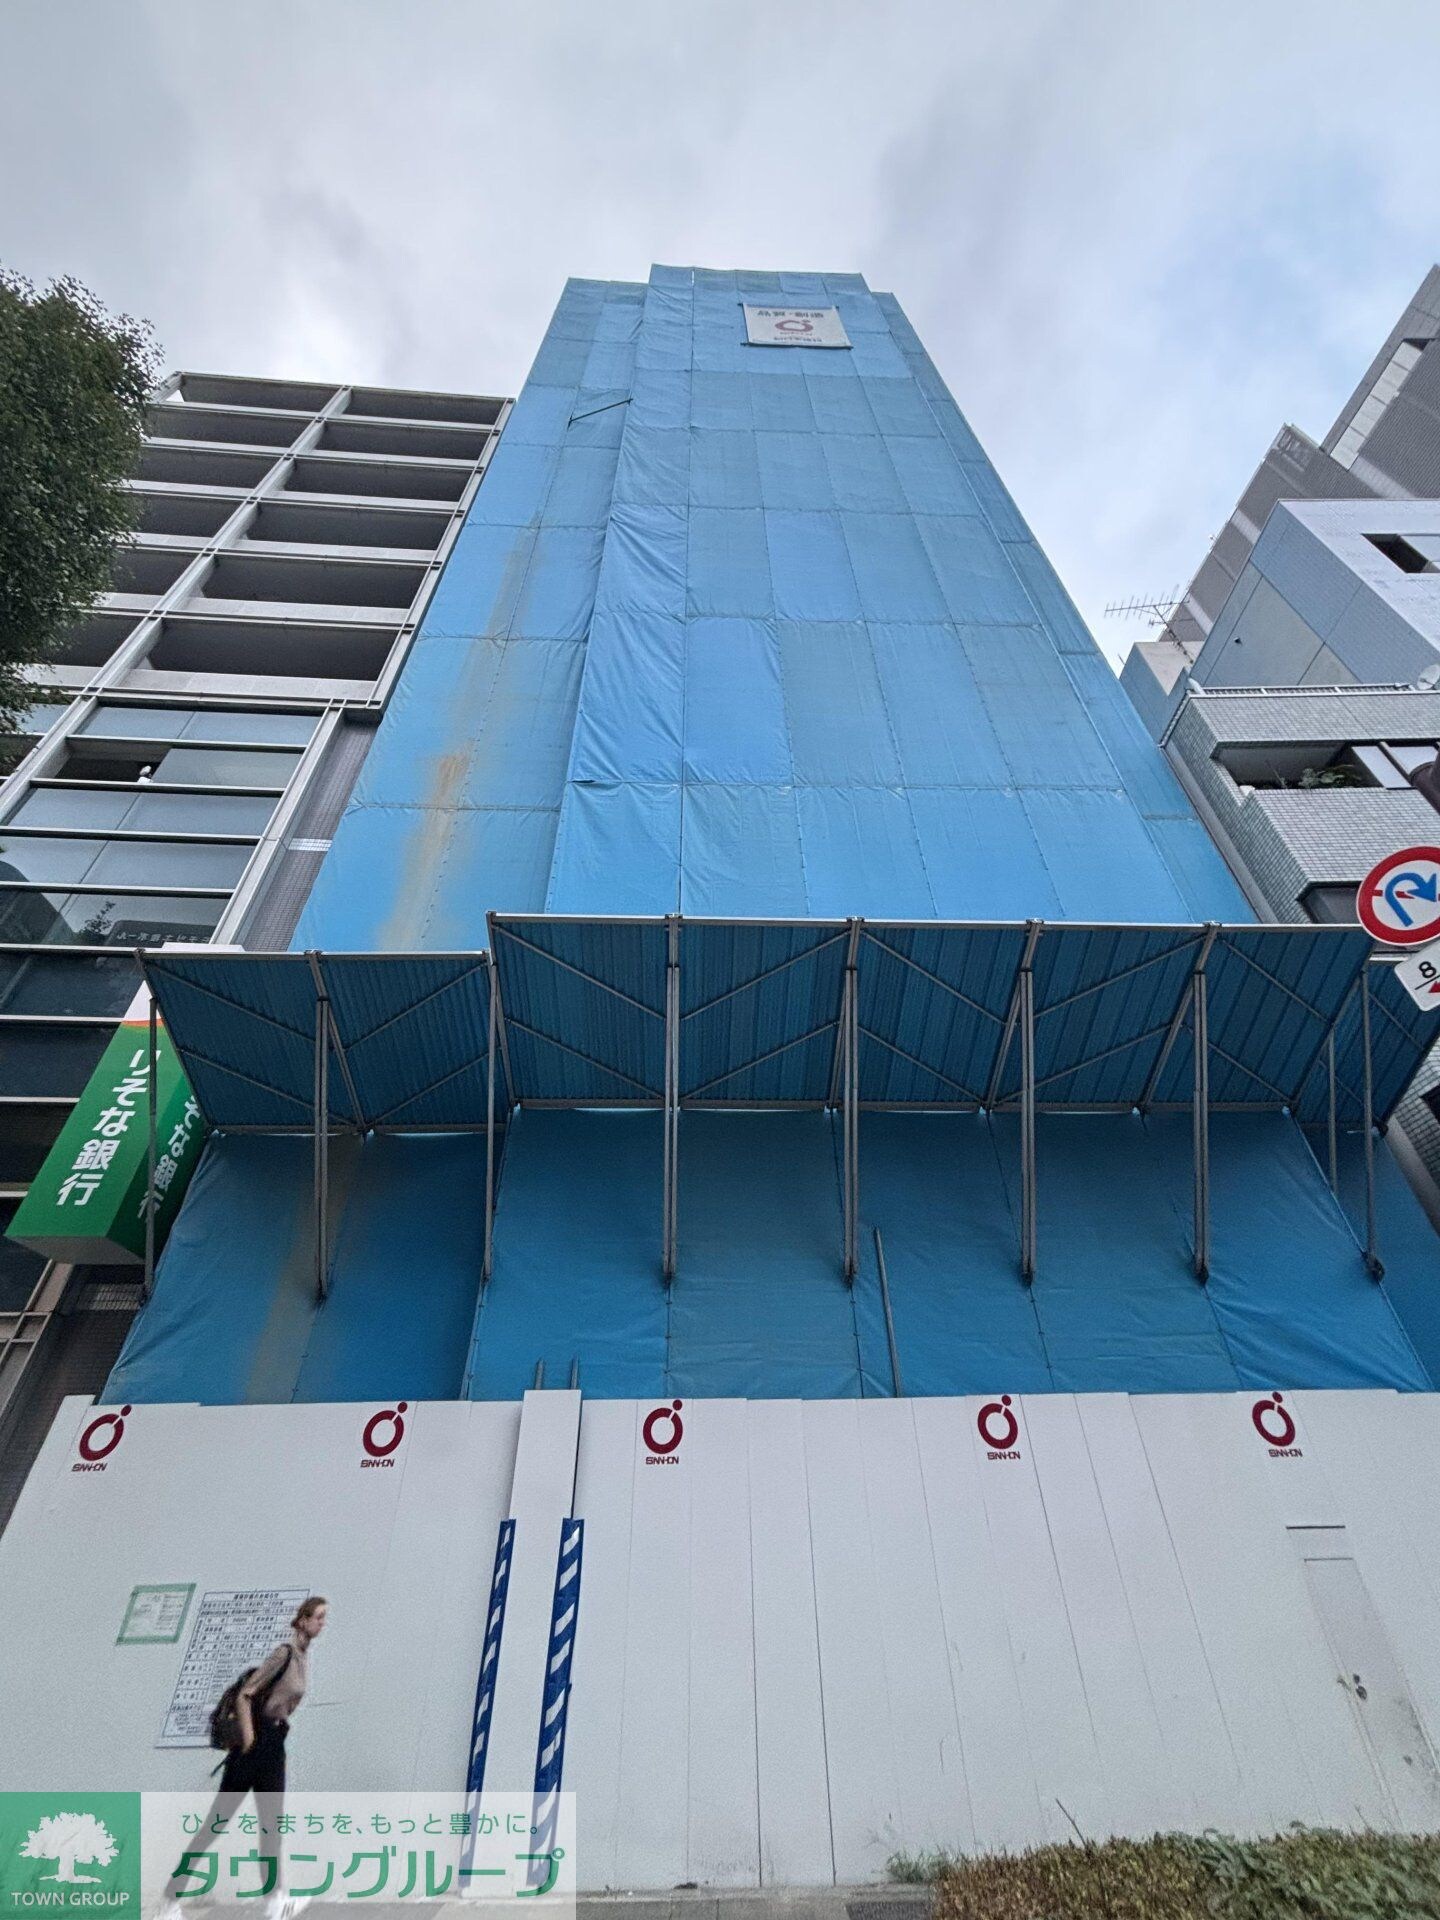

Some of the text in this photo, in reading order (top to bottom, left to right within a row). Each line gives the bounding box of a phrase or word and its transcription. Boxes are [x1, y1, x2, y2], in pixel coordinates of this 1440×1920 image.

[56, 1049, 160, 1206] りそな銀行
